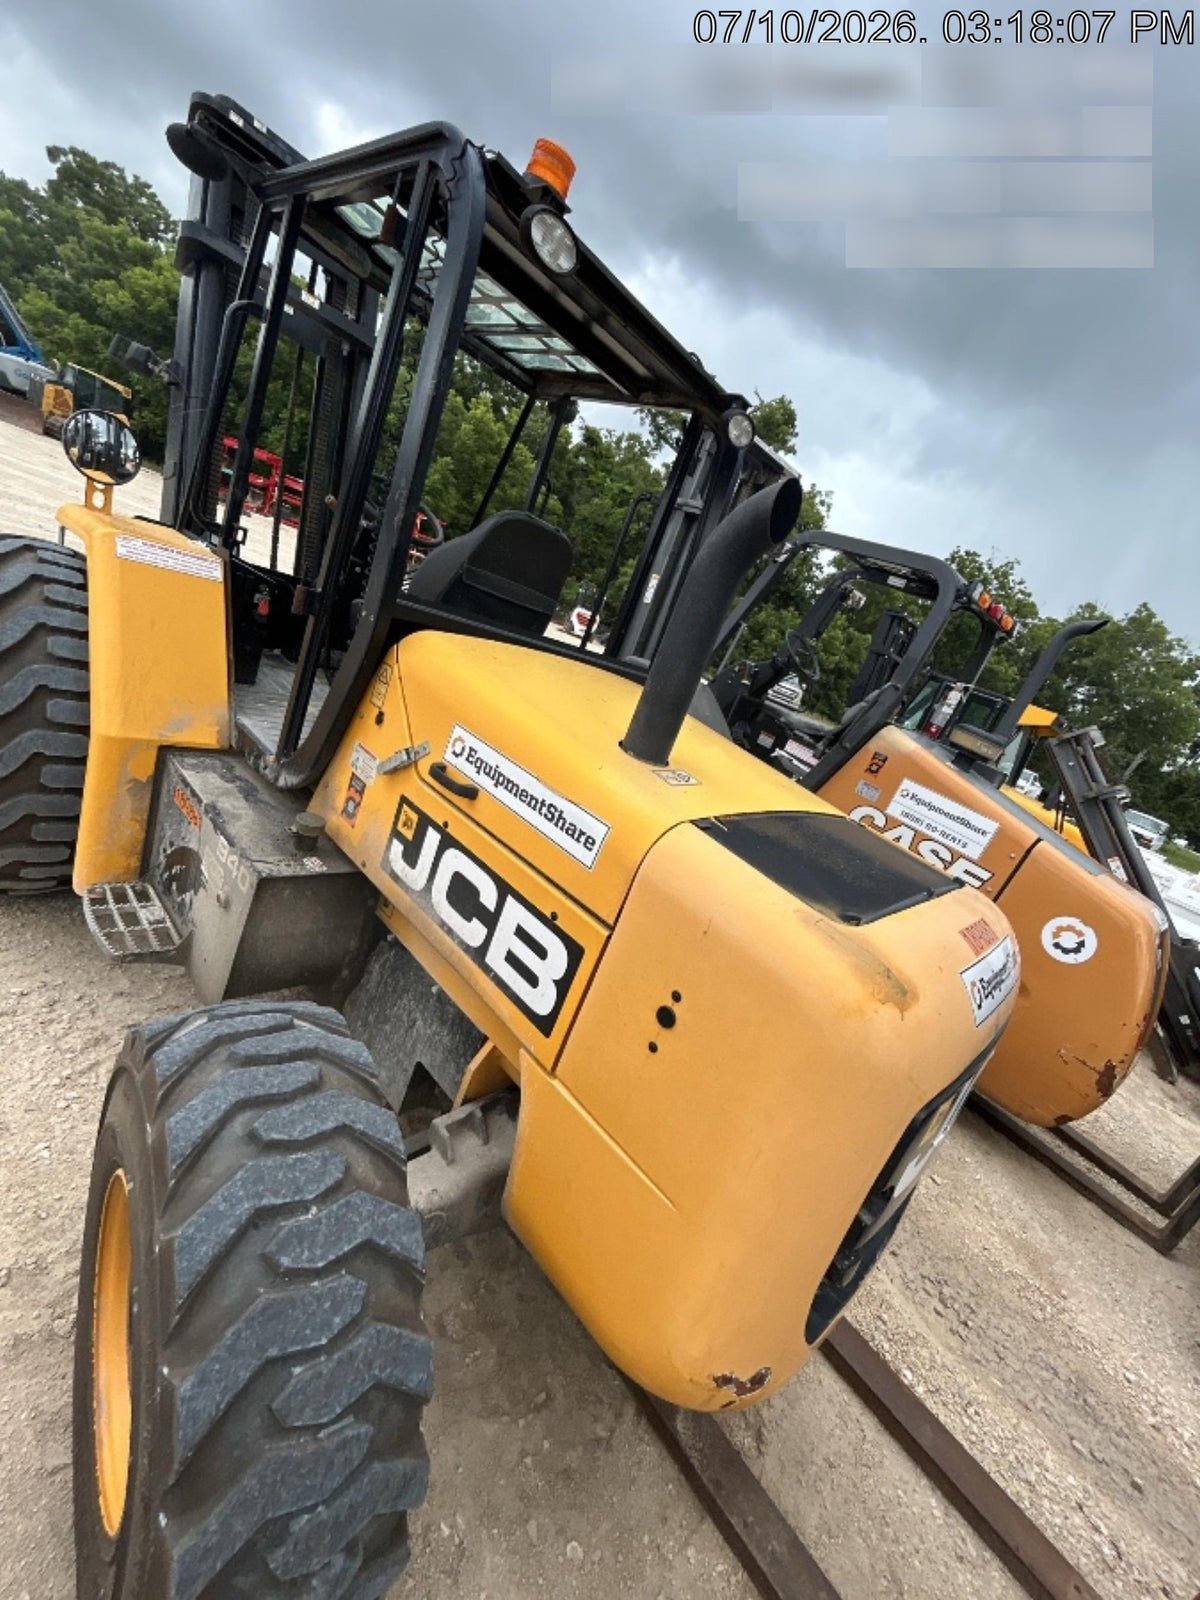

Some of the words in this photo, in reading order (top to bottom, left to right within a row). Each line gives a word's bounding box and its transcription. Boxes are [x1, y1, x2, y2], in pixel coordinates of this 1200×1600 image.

[465, 746, 597, 853] EquipmentShare
[848, 804, 995, 889] CASE
[389, 826, 568, 1016] JCB
